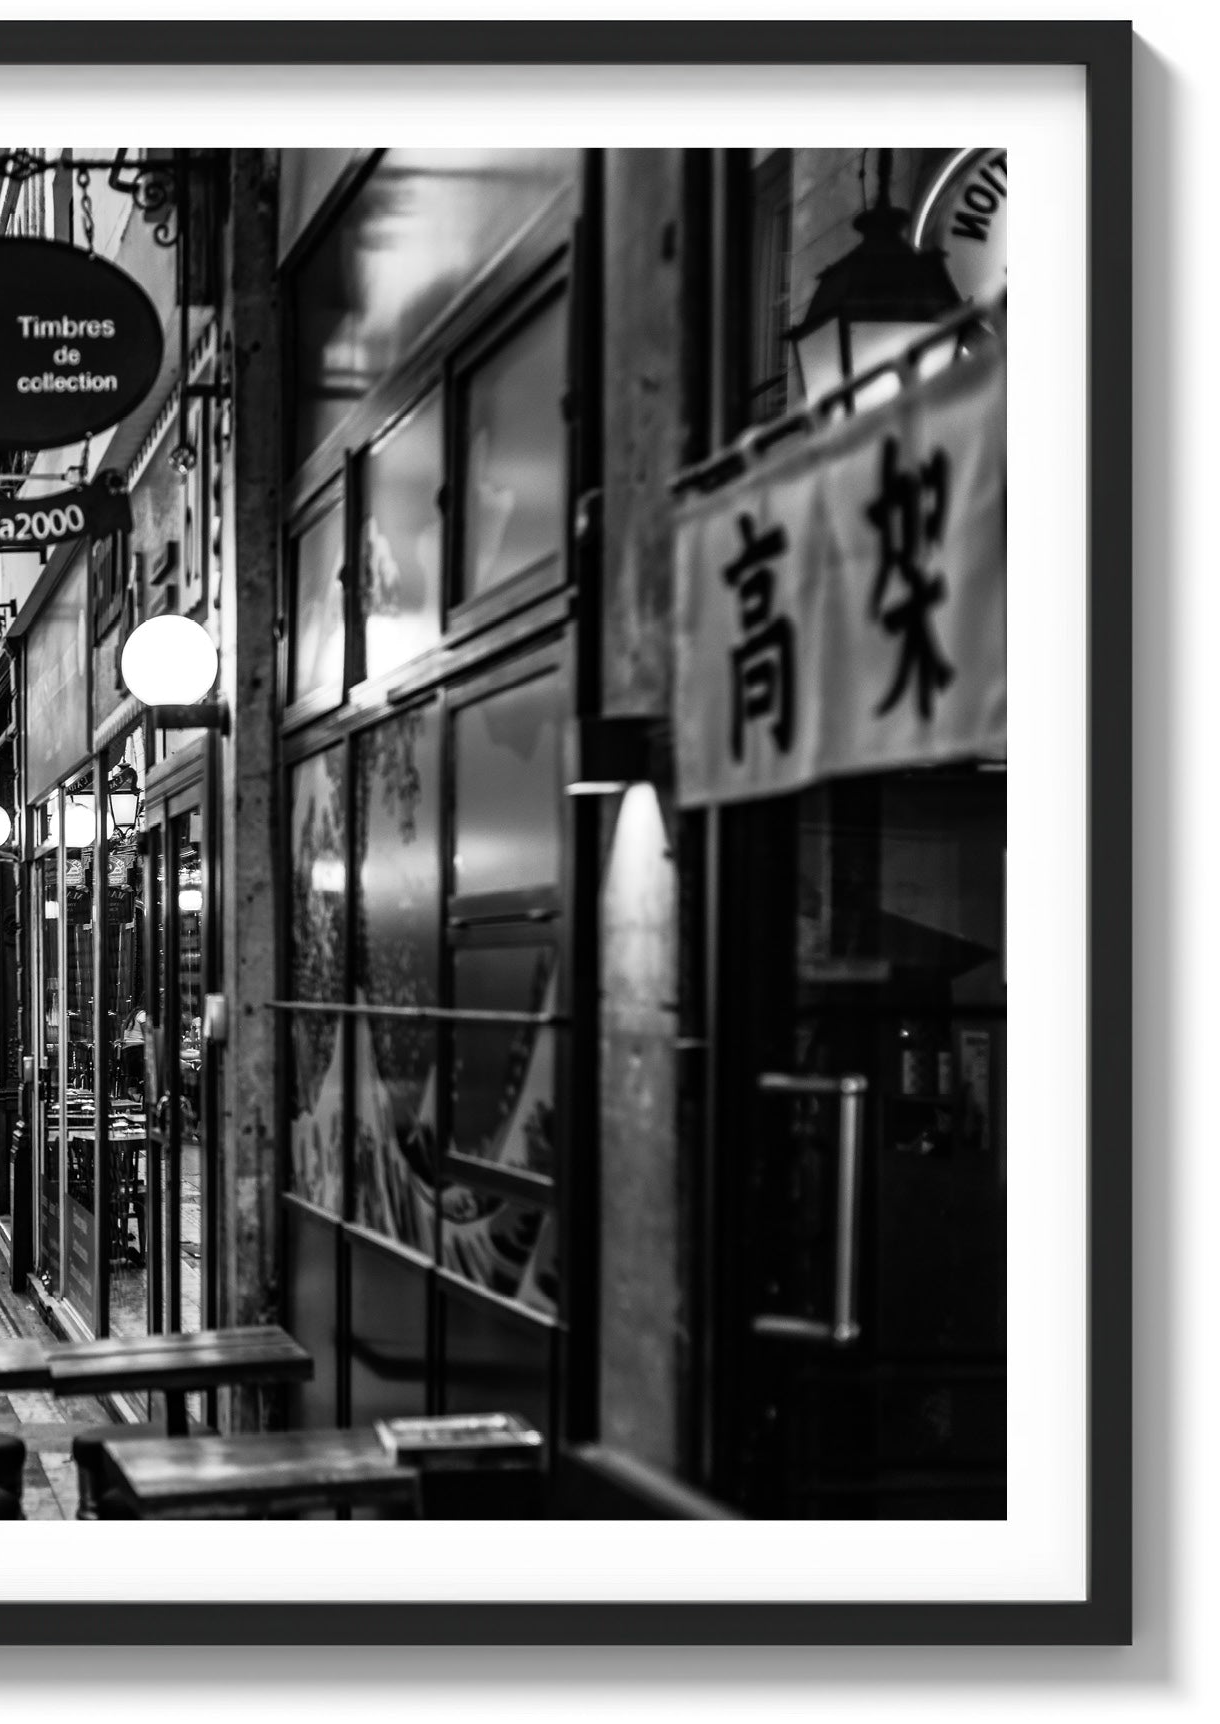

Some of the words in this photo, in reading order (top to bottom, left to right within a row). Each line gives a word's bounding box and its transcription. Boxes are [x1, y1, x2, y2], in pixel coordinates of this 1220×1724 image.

[16, 314, 116, 339] Timbres
[53, 345, 81, 366] de
[16, 371, 119, 394] collection
